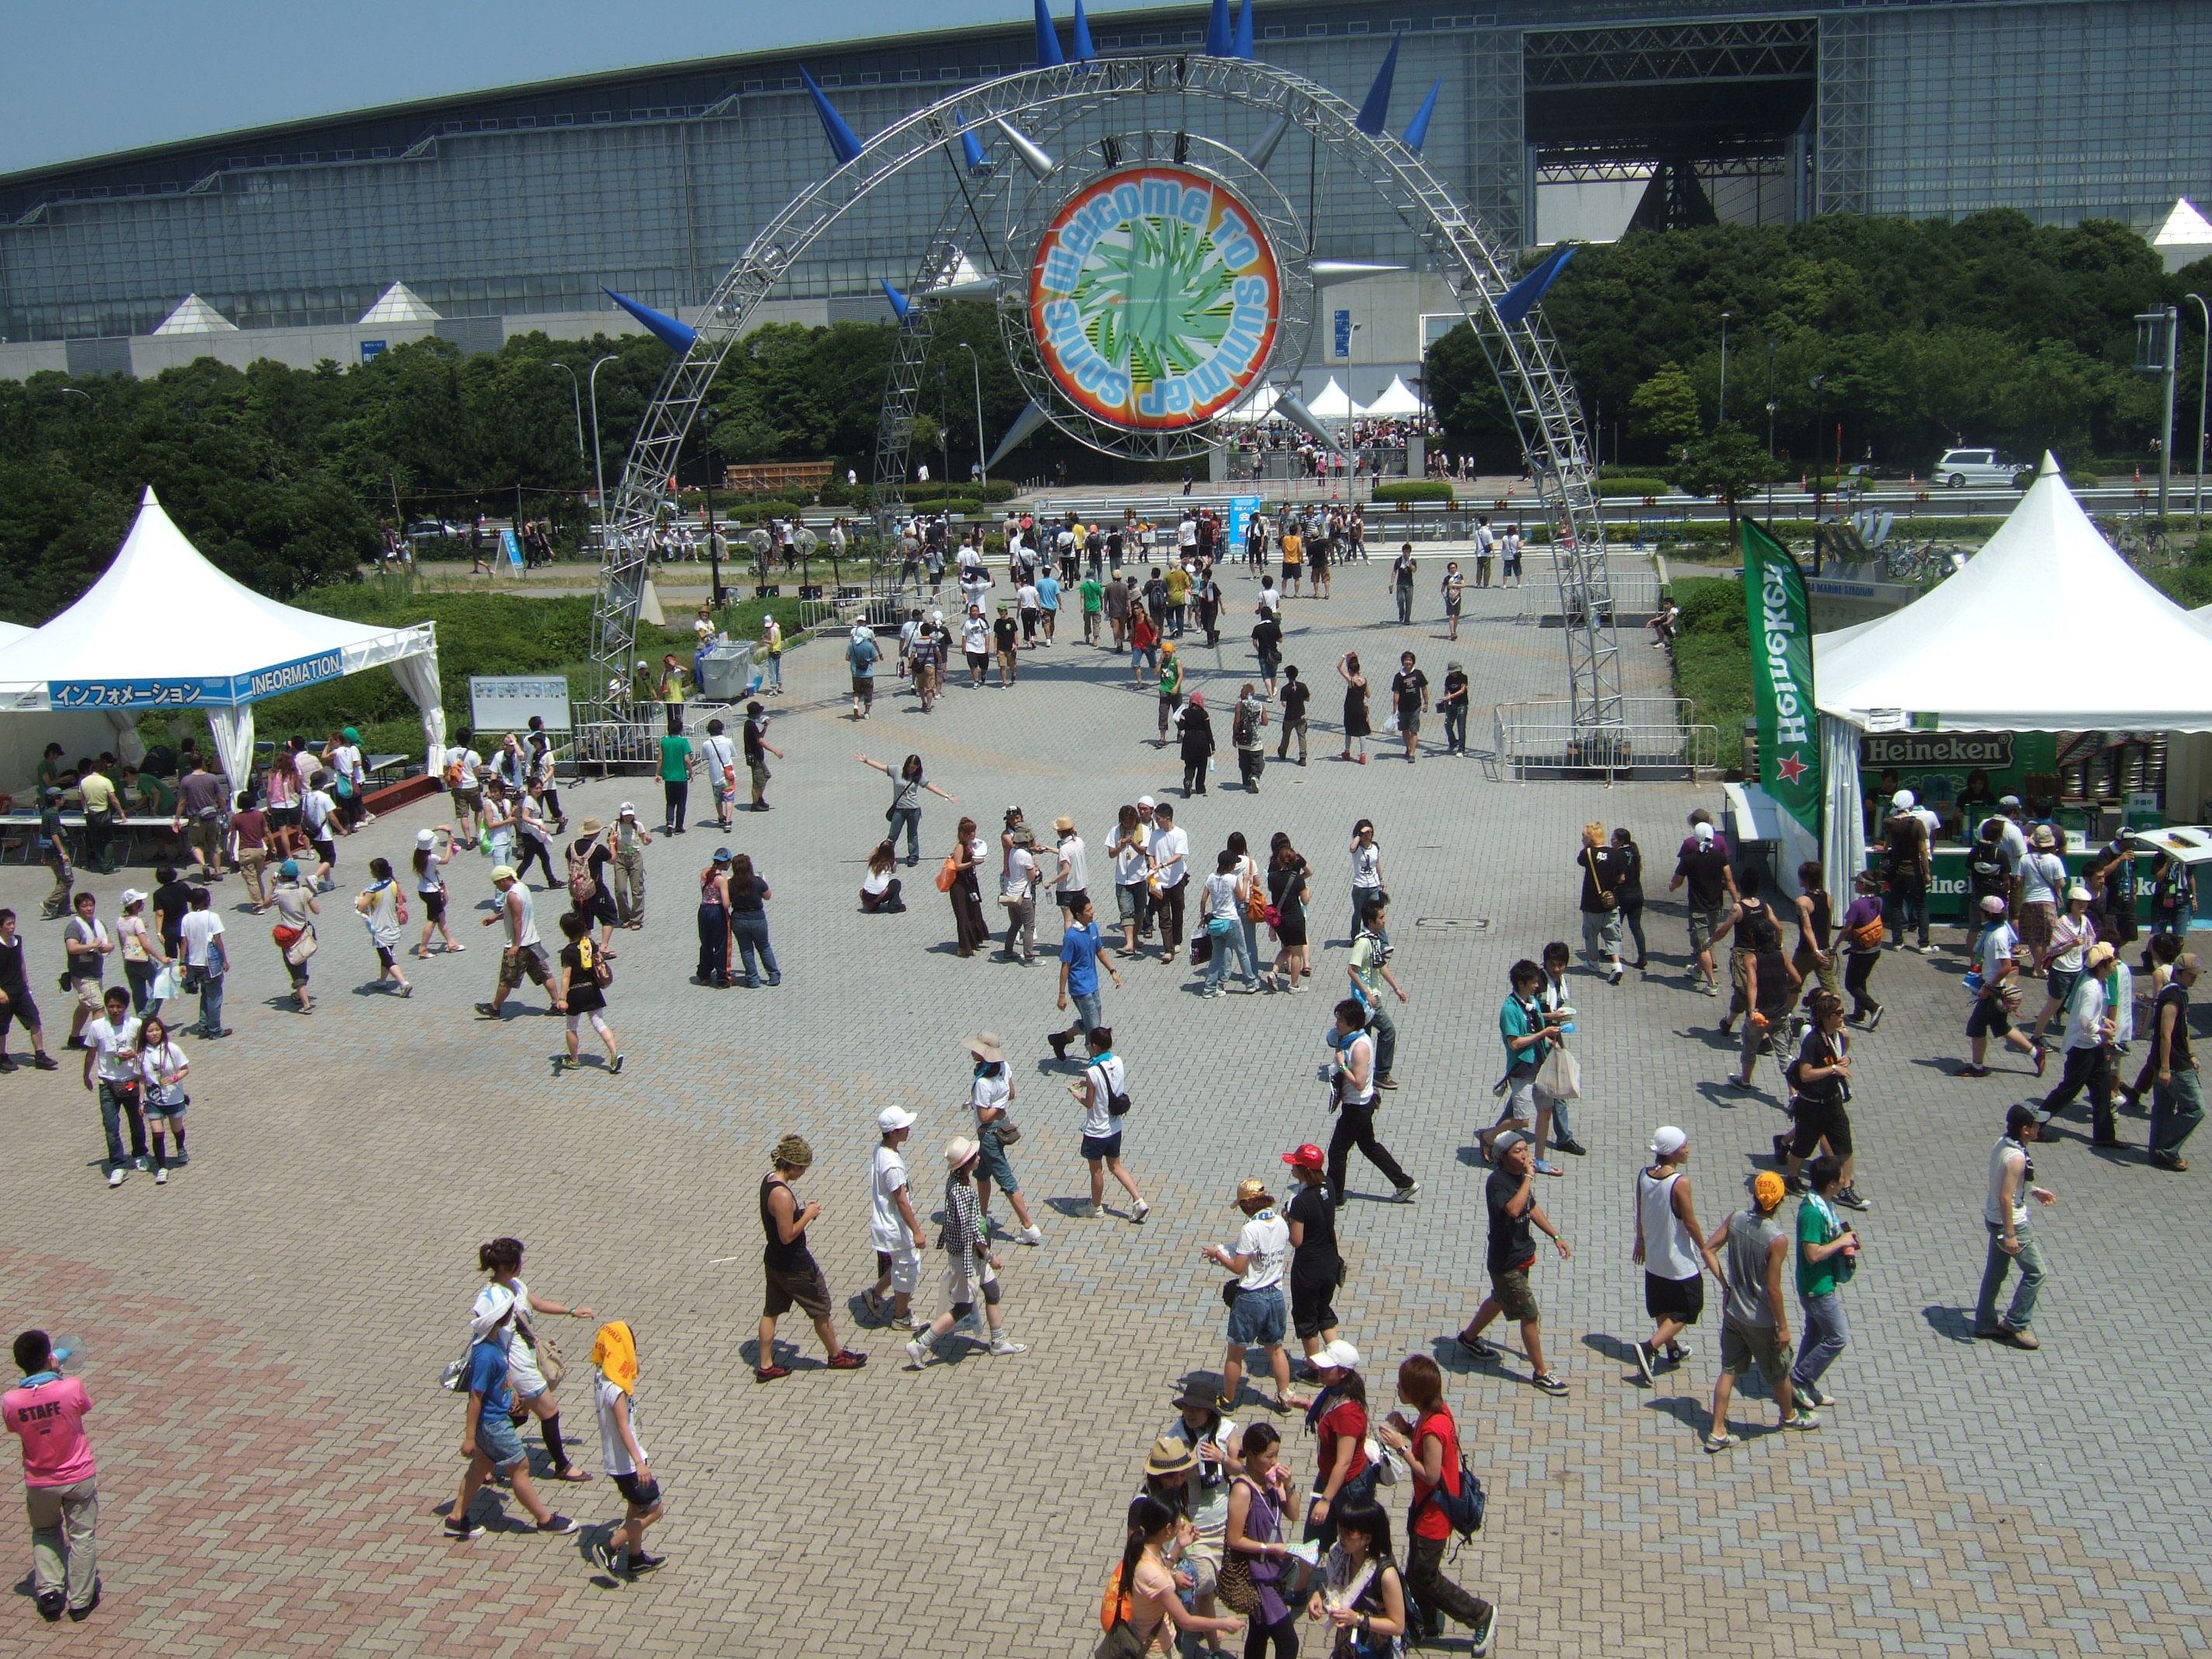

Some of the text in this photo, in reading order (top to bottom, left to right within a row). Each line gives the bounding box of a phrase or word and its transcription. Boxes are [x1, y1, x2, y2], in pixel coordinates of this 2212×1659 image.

[1845, 585, 1874, 596] STADIUM
[1763, 561, 1807, 744] Heineken
[251, 654, 340, 696] INFORMATION
[57, 683, 200, 707] インフォメーション
[1868, 738, 2002, 762] Heineken
[18, 1401, 61, 1423] STAFF
